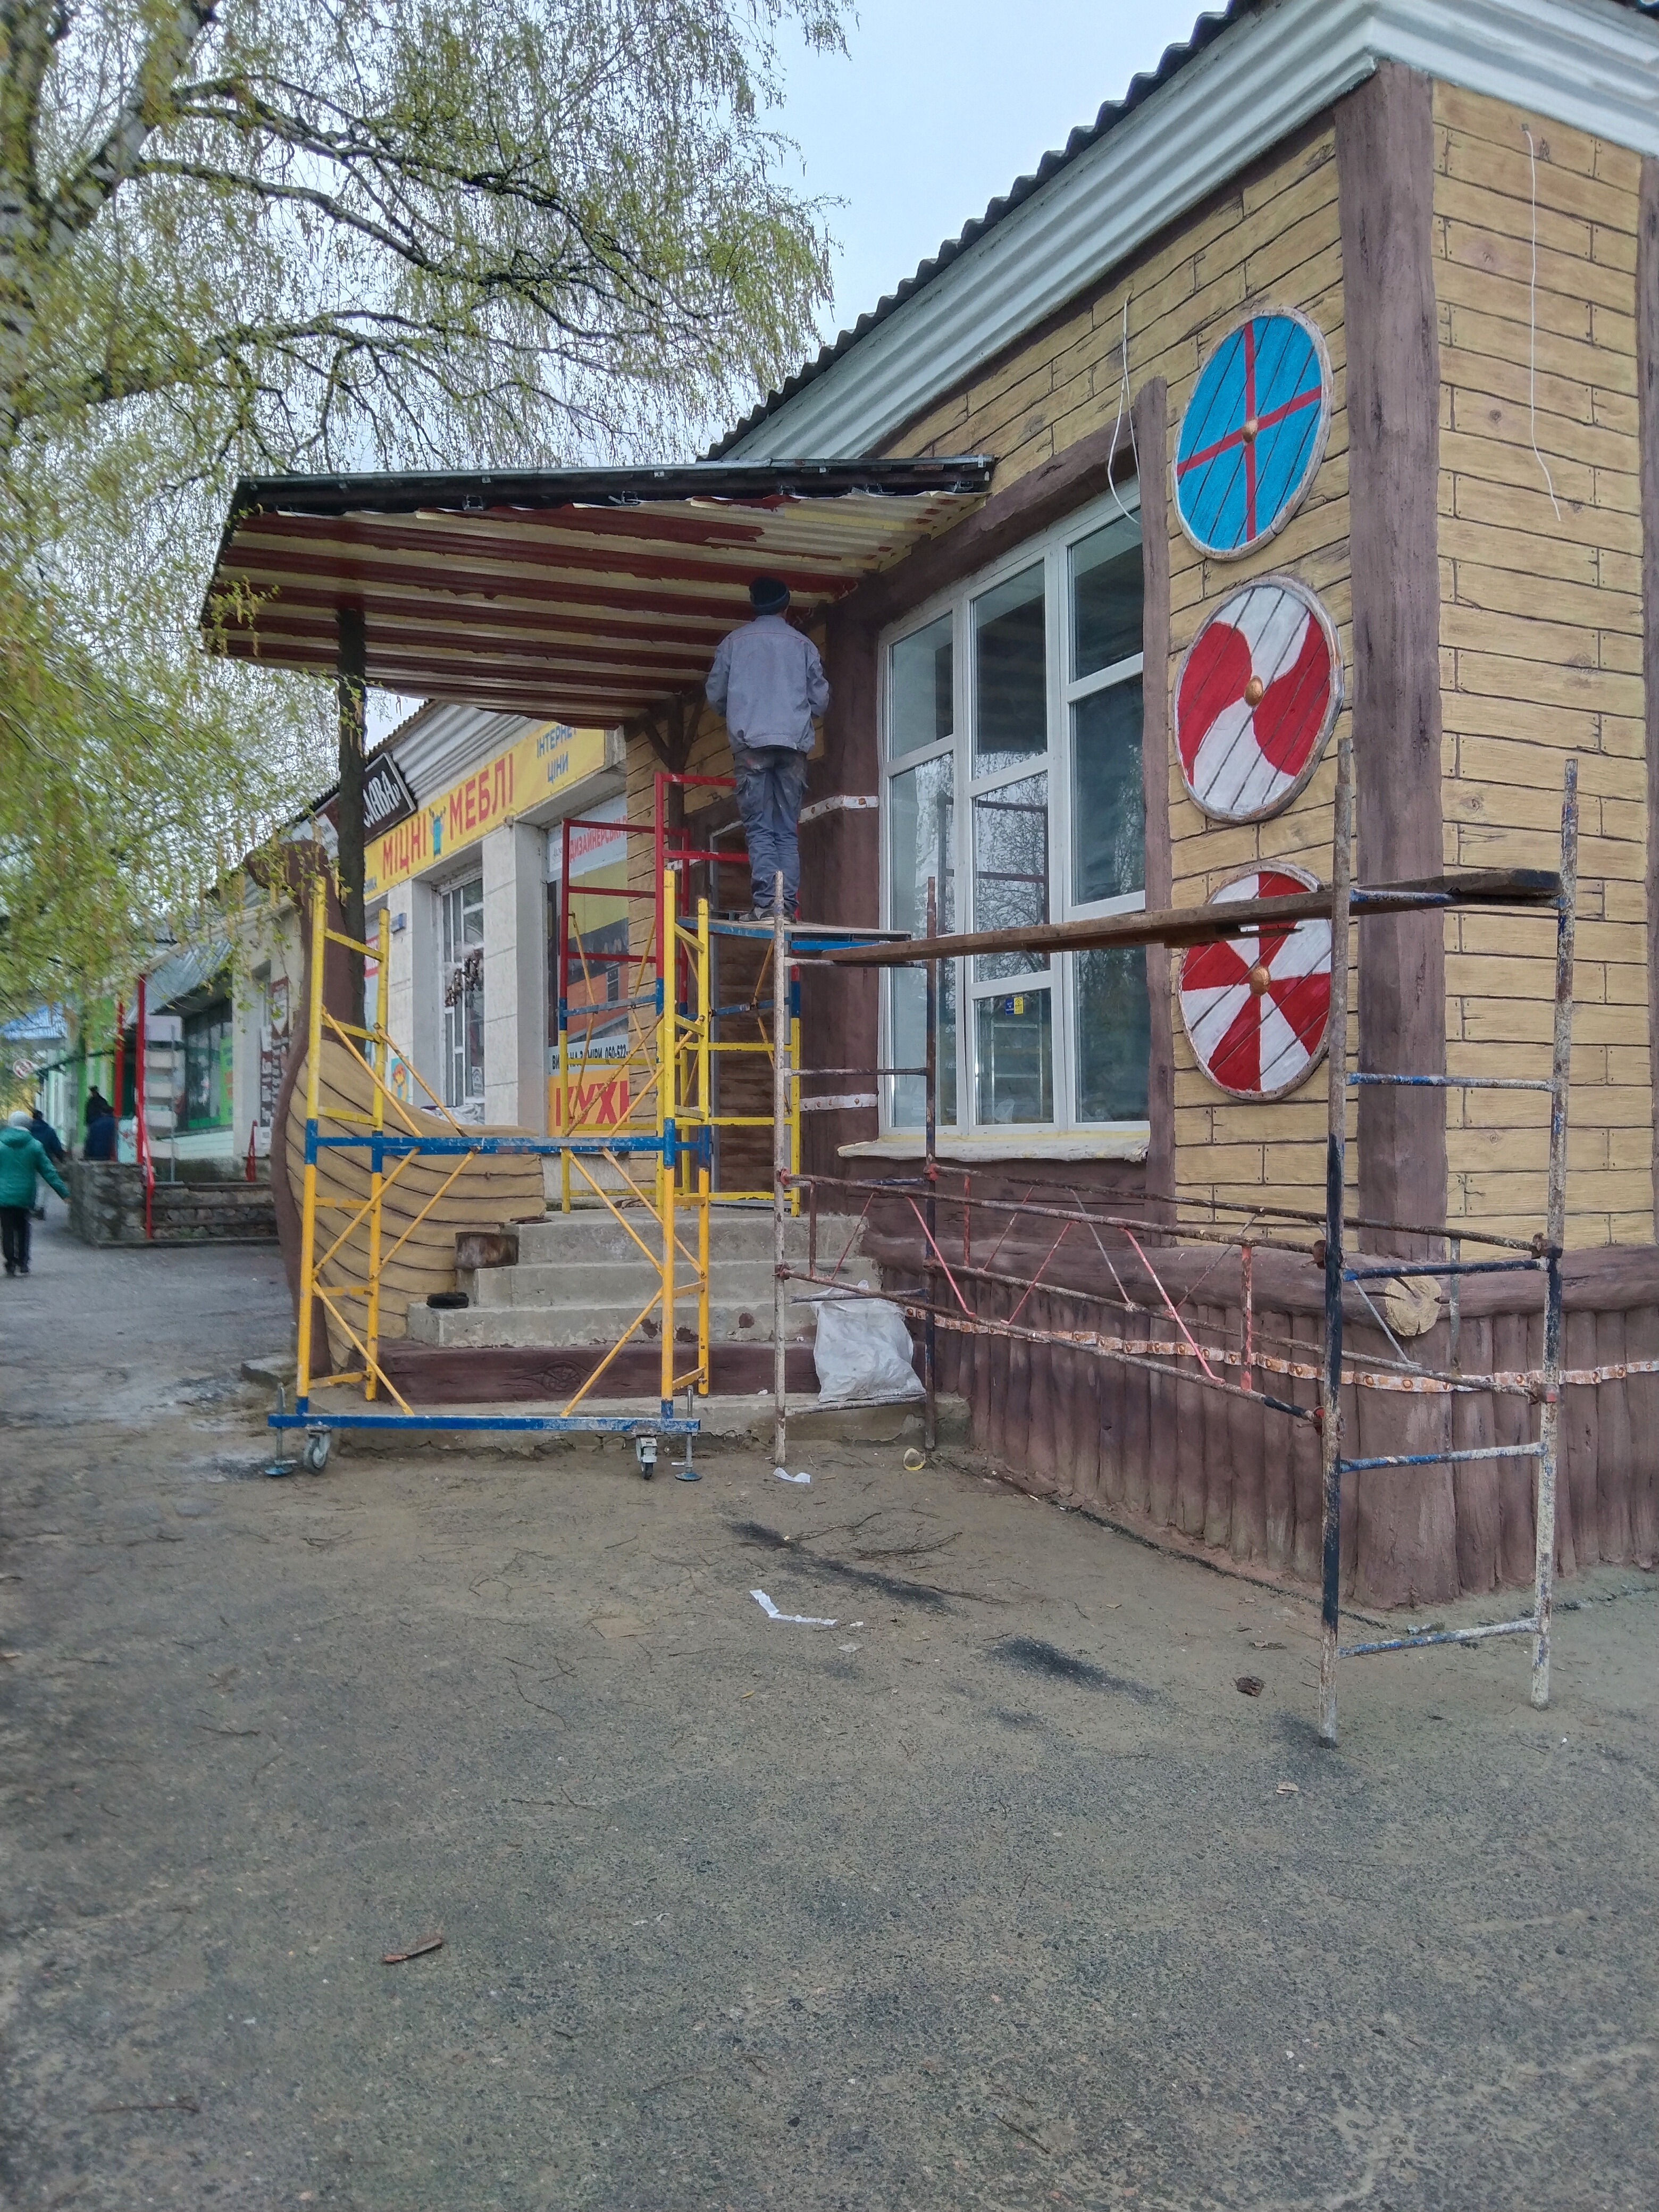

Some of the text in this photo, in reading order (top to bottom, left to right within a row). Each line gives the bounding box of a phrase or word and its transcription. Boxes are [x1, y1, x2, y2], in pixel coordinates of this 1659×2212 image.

[547, 751, 568, 784] ЦІНИ
[382, 752, 513, 881] МІЦНІ МЕБЛІ
